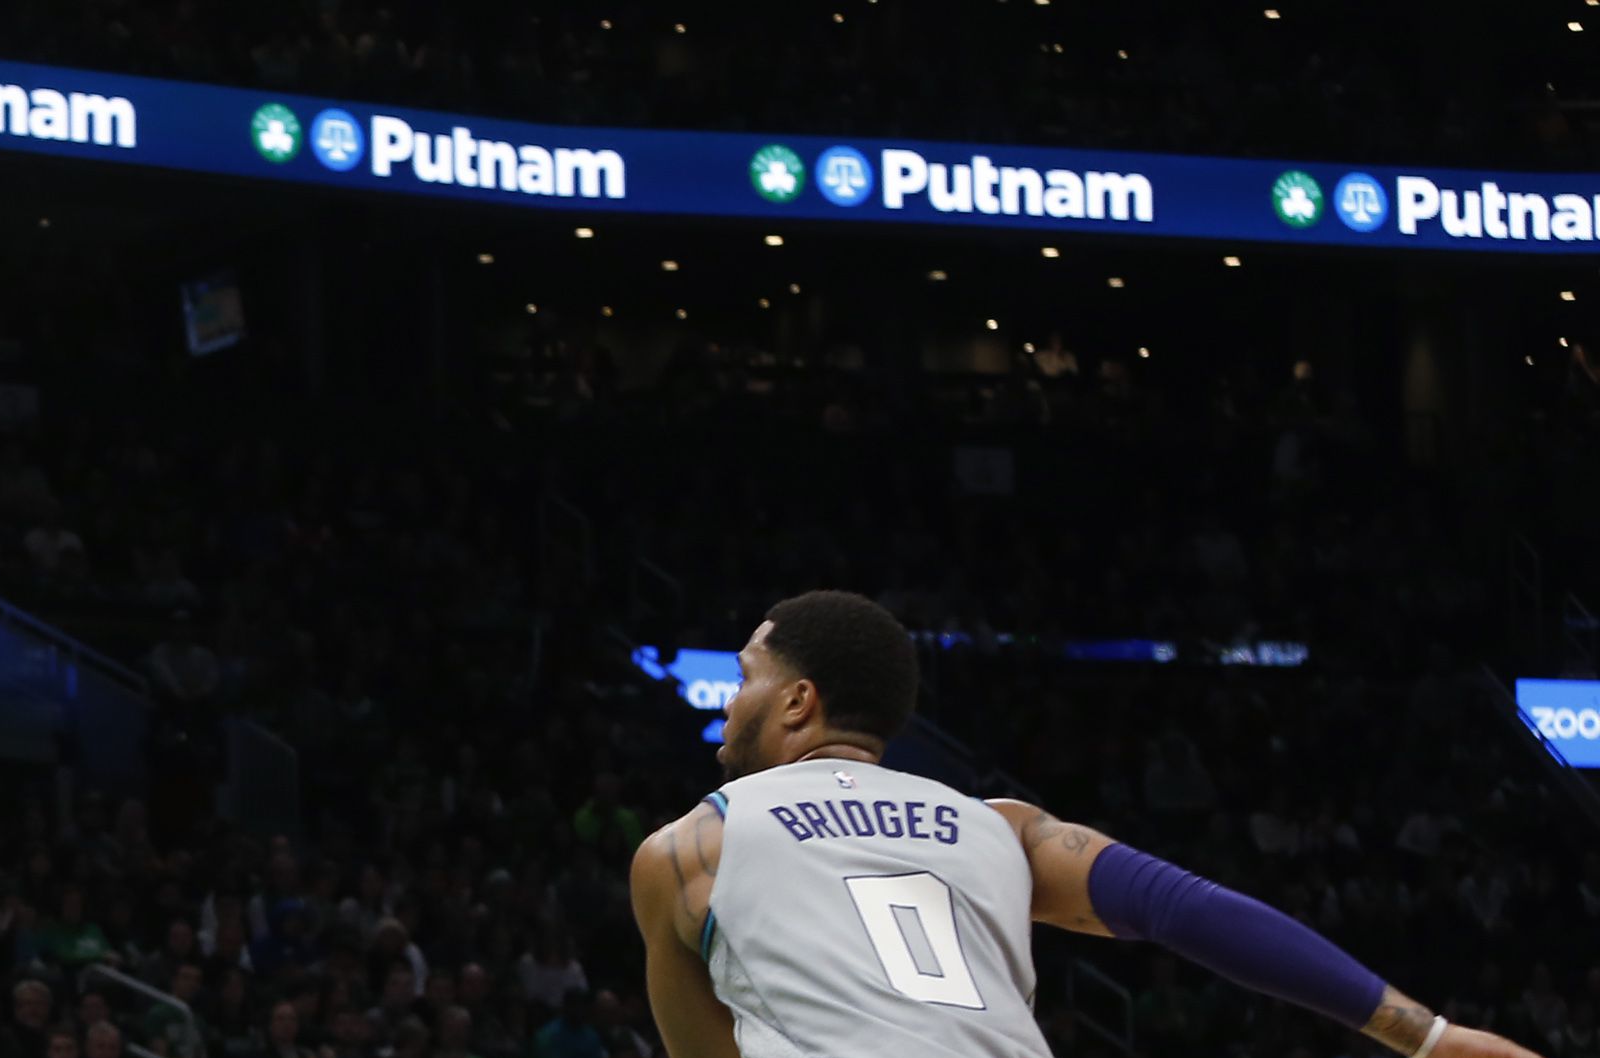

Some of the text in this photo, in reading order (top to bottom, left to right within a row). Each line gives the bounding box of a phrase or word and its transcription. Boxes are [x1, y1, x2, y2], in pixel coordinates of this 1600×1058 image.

[371, 115, 626, 199] Putnam
[881, 149, 1153, 222] Putnam
[1397, 176, 1600, 241] Putna
[769, 799, 959, 845] BRIDGES
[843, 871, 987, 1010] 0
